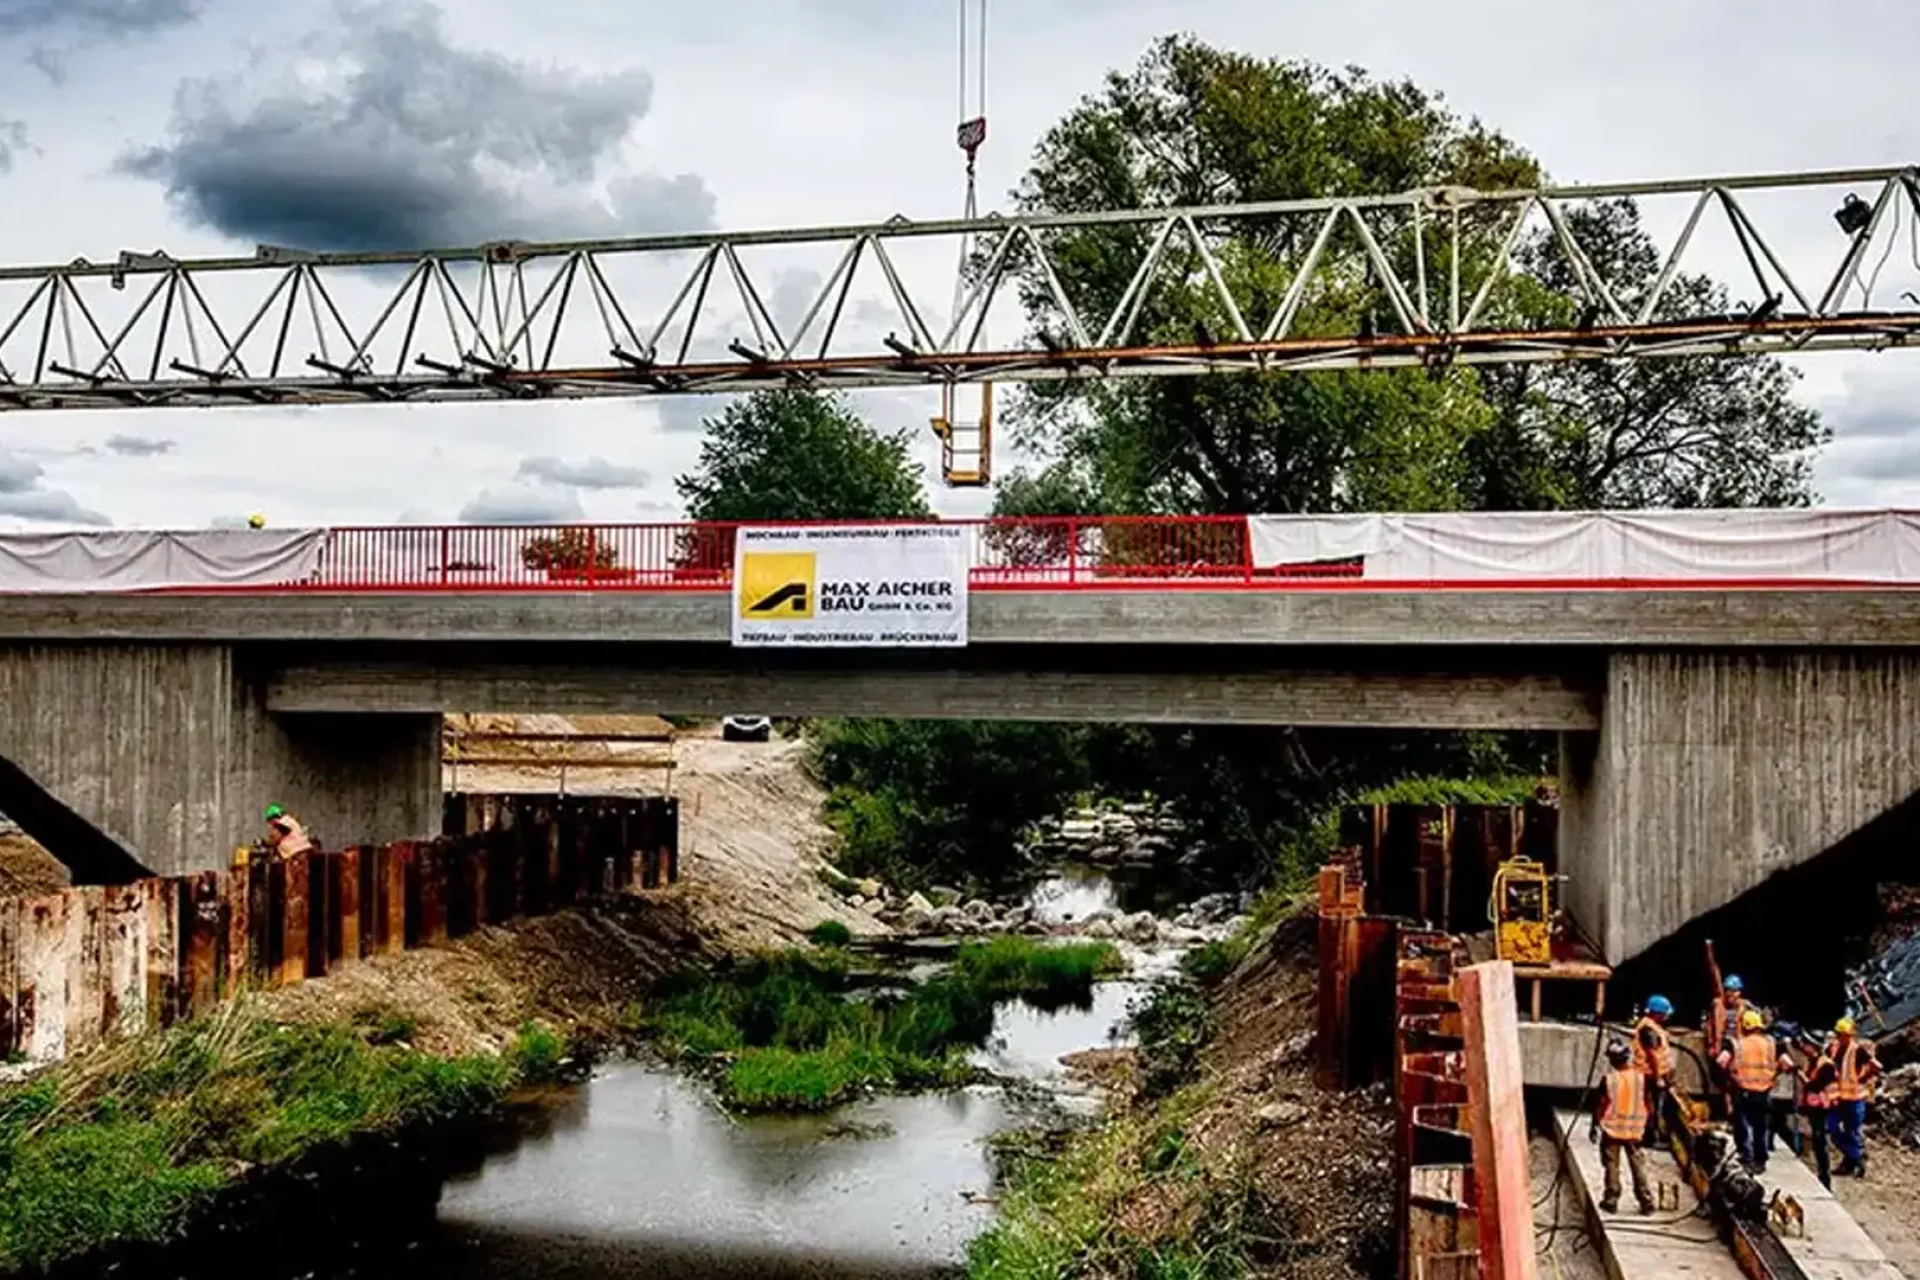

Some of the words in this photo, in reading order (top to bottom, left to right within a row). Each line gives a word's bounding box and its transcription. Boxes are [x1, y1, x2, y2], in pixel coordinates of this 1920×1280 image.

[821, 582, 870, 596] MAX
[876, 582, 952, 596] AICHER
[821, 597, 864, 611] BAU
